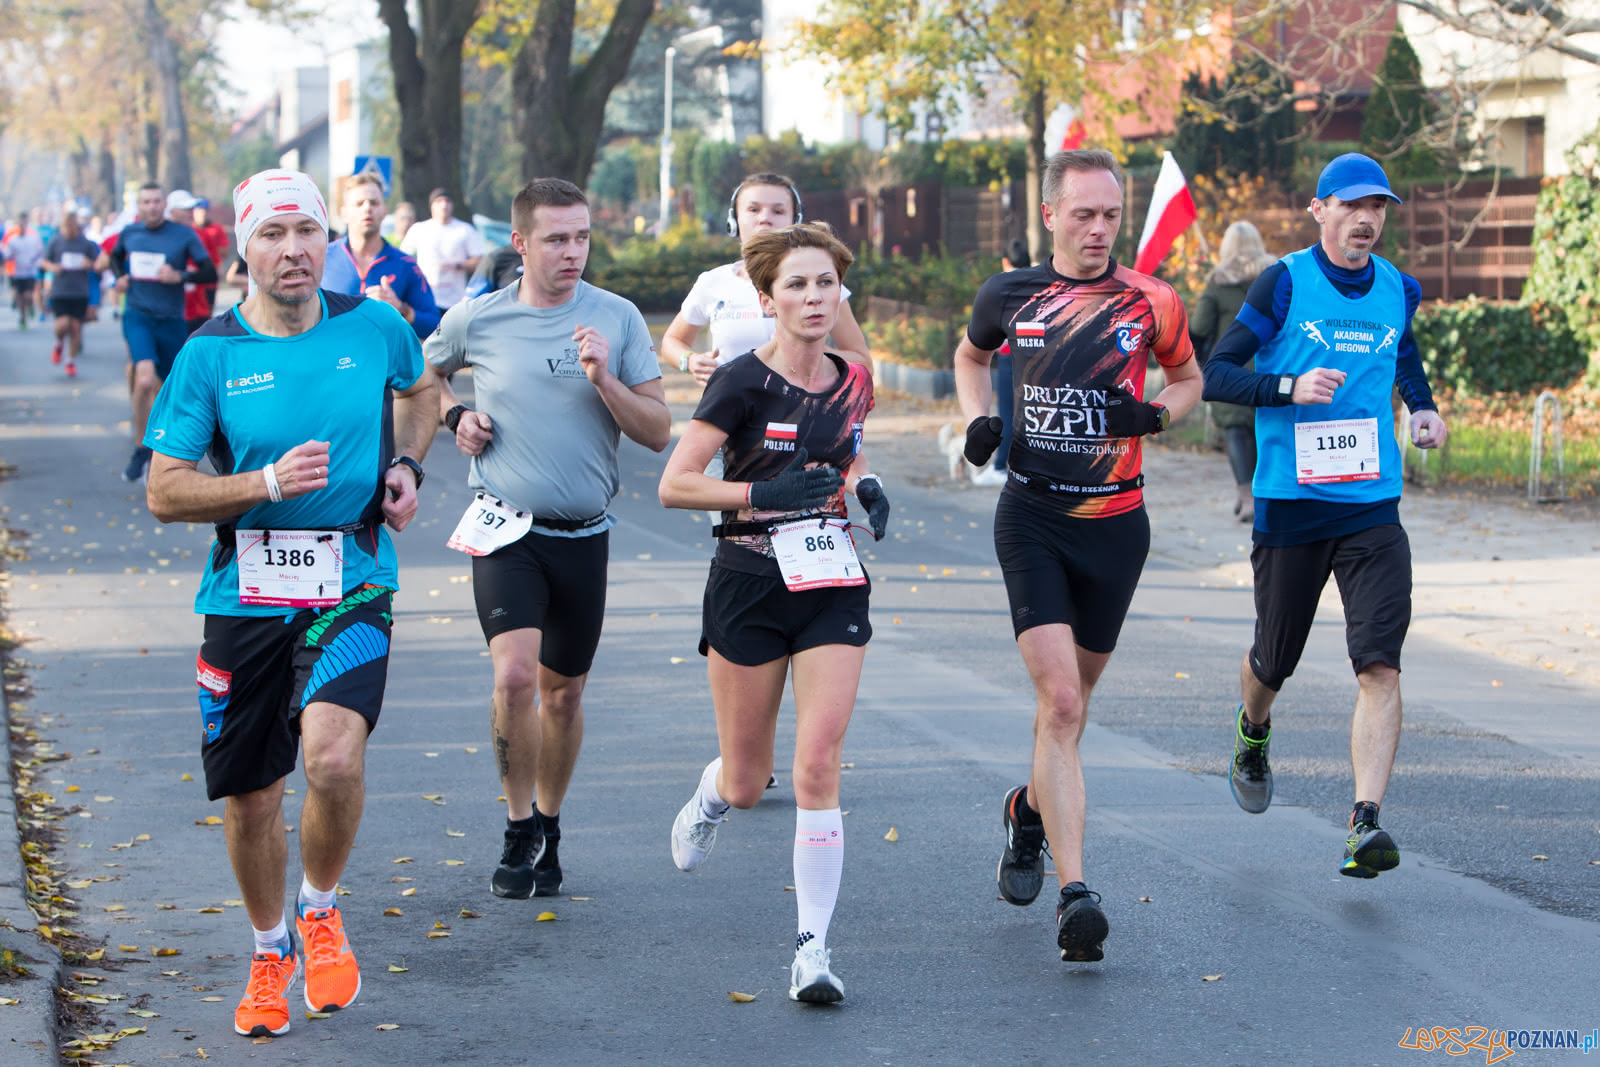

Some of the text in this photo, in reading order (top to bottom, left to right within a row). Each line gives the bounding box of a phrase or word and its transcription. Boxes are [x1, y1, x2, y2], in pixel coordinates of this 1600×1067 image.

[1016, 338, 1045, 348] POLSKA
[1333, 330, 1374, 342] AKADEMIA
[1335, 342, 1370, 353] BIEGOWA
[226, 371, 274, 389] exactus
[1023, 383, 1108, 407] DRUŻYN
[763, 439, 795, 452] POLSKA
[1026, 438, 1129, 457] www.darszpiku.pl
[1316, 434, 1357, 451] 1180
[1059, 484, 1080, 493] BIEG
[476, 508, 506, 530] 797
[805, 535, 835, 552] 866
[264, 549, 316, 567] 1386
